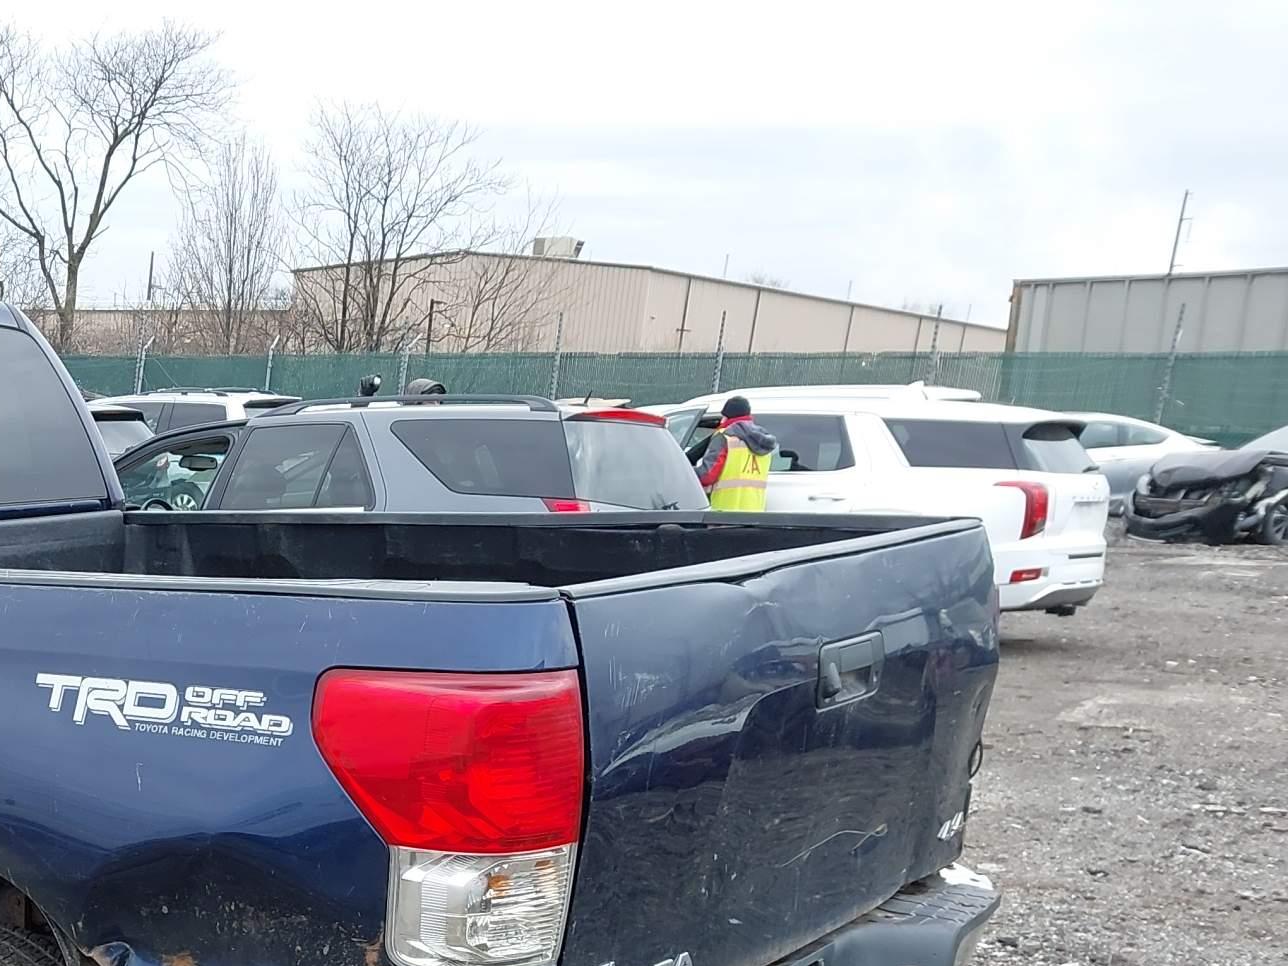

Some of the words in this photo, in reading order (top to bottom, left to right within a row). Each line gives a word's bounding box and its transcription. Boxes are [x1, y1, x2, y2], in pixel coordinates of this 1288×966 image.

[35, 673, 180, 730] TRD
[184, 685, 267, 711] OFF
[134, 722, 171, 735] TOYOTA
[171, 726, 208, 740] RACING
[209, 730, 285, 747] DEVELOPMENT
[180, 706, 294, 736] ROAD
